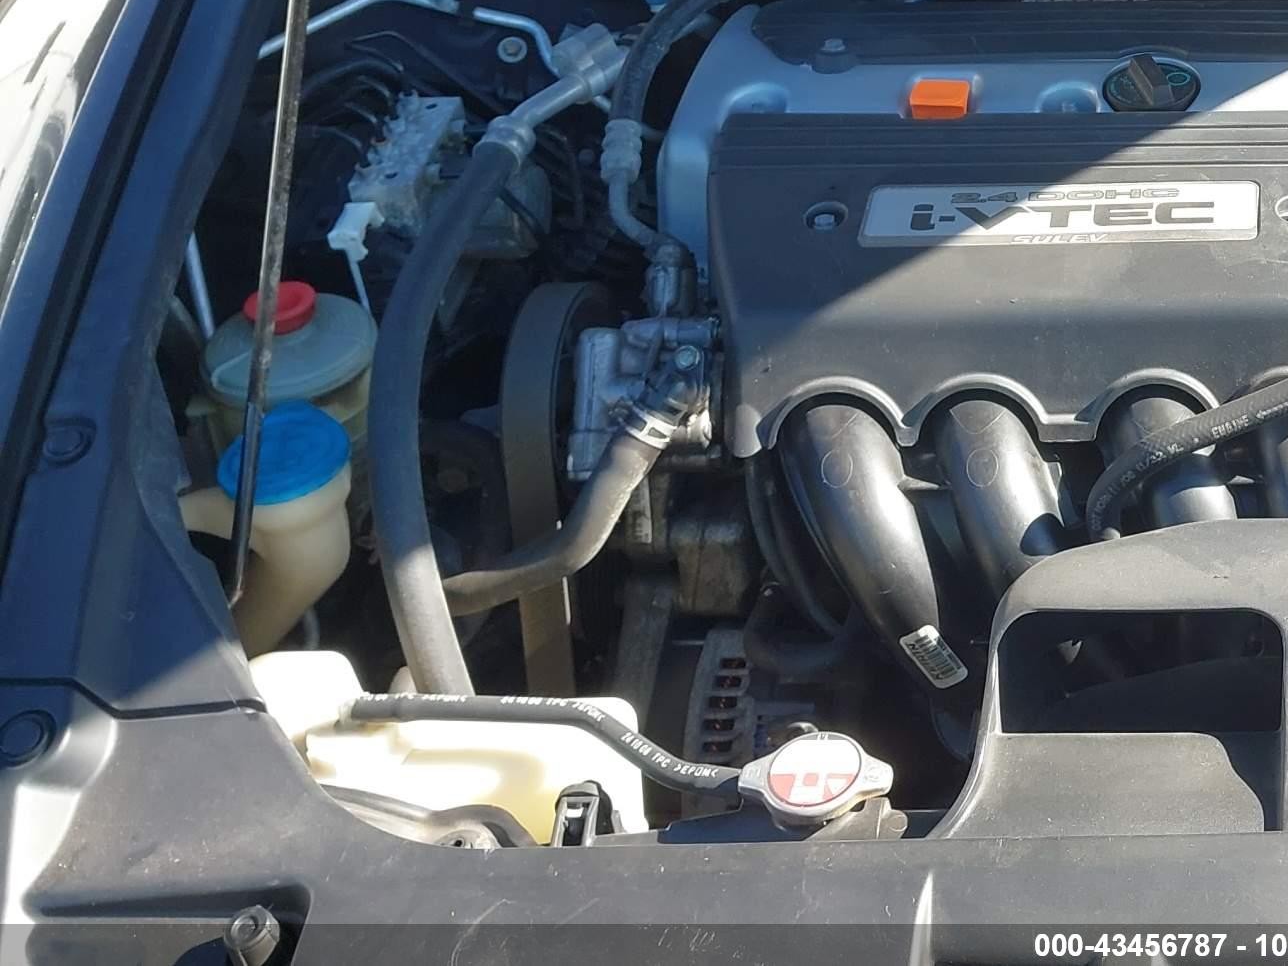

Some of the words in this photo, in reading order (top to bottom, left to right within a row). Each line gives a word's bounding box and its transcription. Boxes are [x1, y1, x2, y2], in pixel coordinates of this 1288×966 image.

[951, 191, 1018, 204] 2.4
[1028, 188, 1180, 202] DOHC
[910, 201, 1215, 231] i-VTEC
[1011, 233, 1109, 244] SULEV
